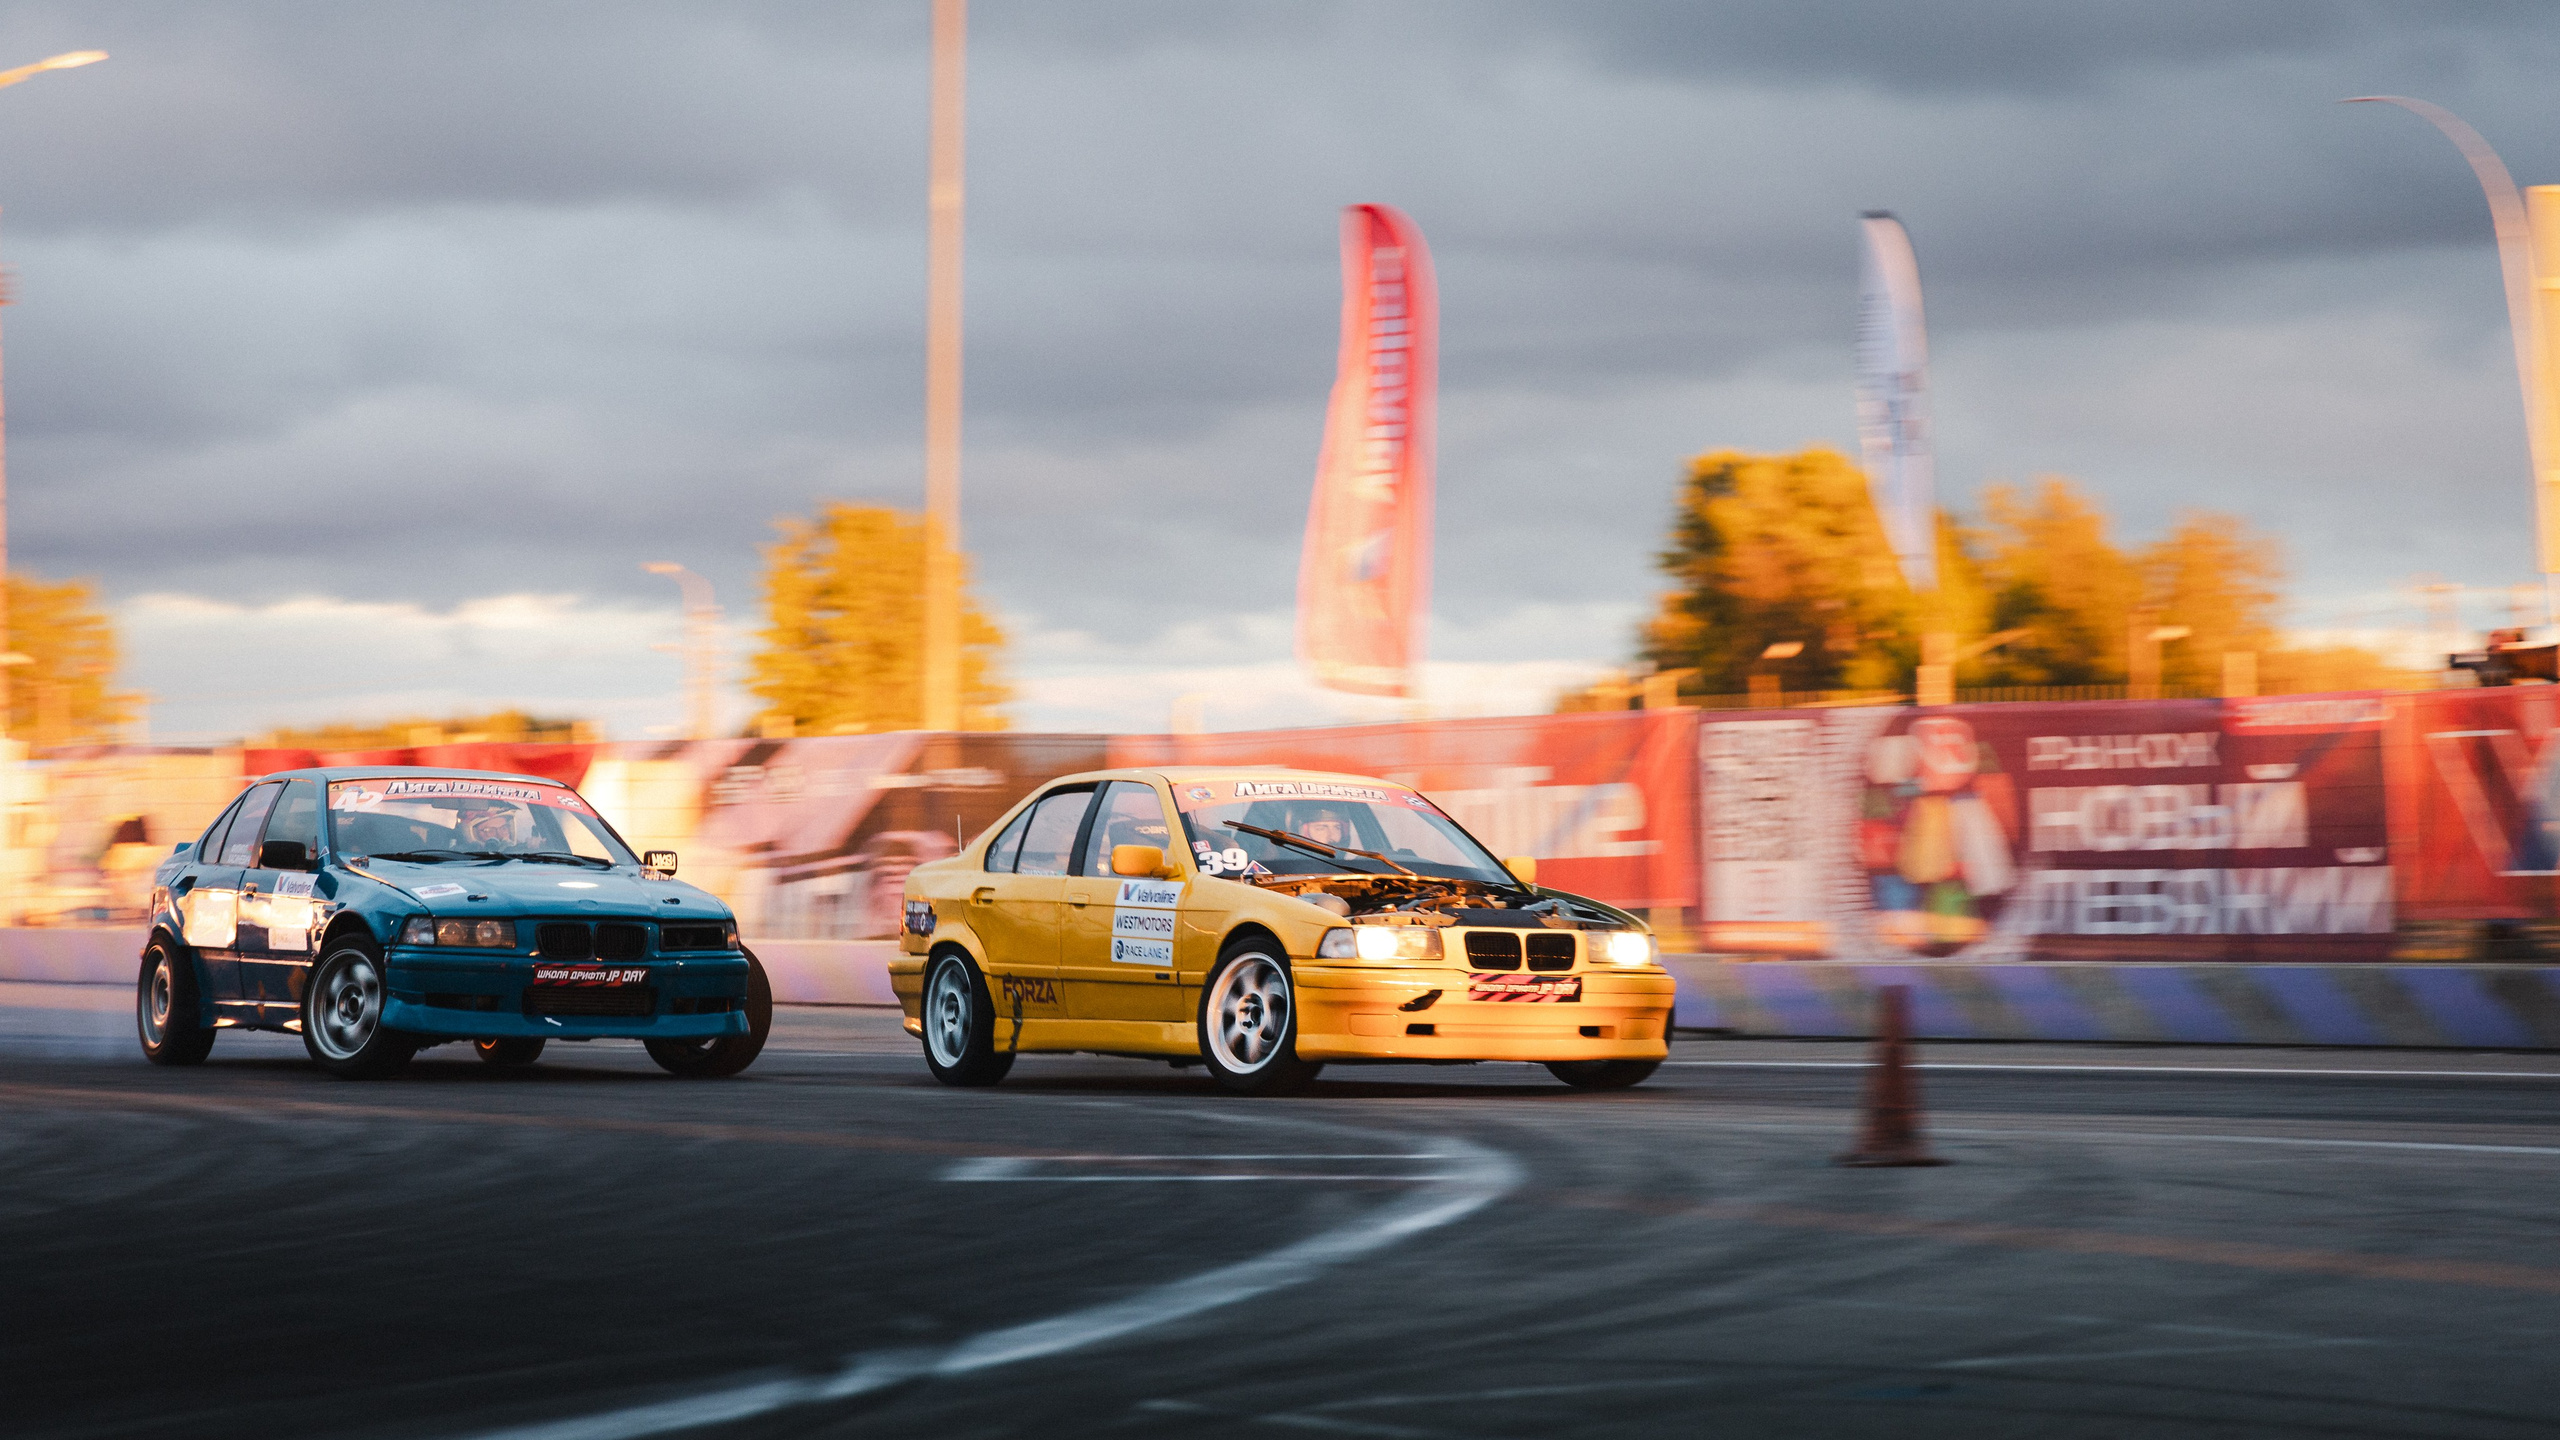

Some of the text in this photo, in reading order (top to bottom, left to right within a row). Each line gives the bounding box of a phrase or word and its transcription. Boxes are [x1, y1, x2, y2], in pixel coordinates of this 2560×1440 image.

[332, 791, 384, 813] 42
[2028, 763, 2310, 852] НОВЫЙ
[1198, 848, 1248, 875] 39
[286, 880, 311, 895] Valvoline
[1137, 888, 1176, 904] Valvoline
[1115, 914, 1172, 932] WESTMOTORS
[537, 969, 646, 982] ШКОЛА ДРИФТА JP DAY
[1002, 977, 1058, 1004] FORZA
